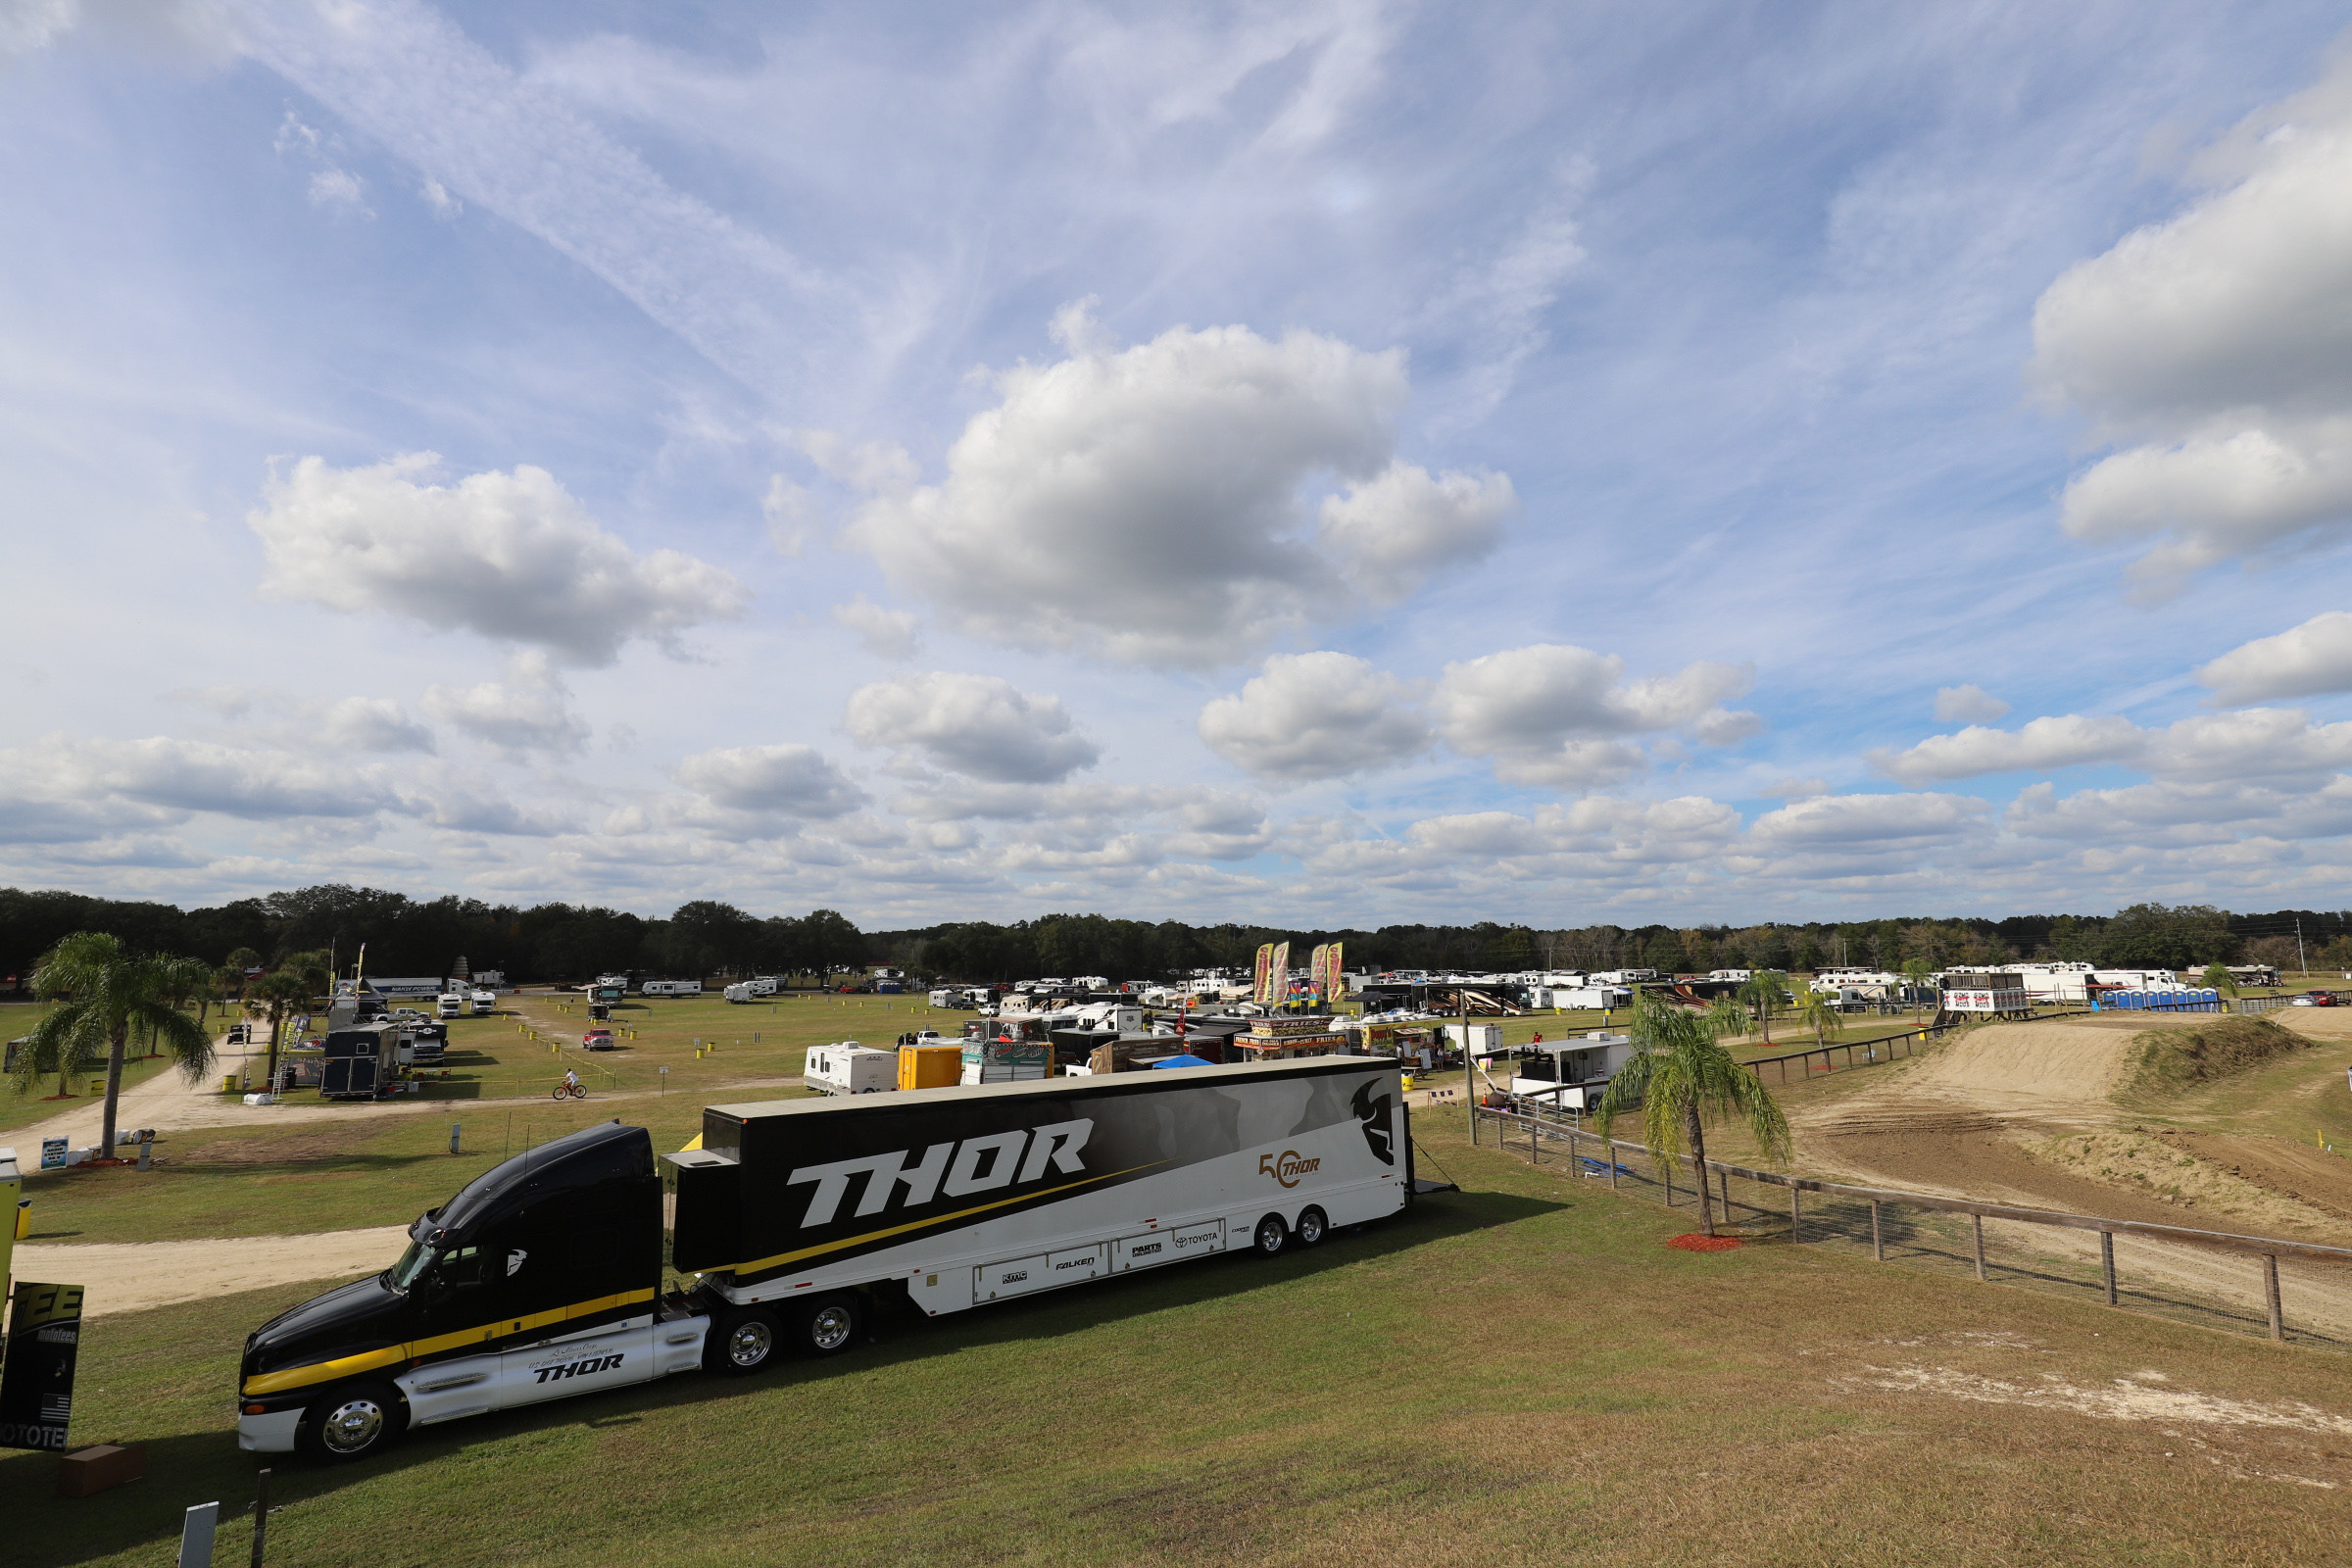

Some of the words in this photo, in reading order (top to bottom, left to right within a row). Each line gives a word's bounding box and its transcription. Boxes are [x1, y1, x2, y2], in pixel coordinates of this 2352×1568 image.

[786, 1117, 1095, 1229] THOR
[1283, 1157, 1321, 1177] THOR
[1188, 1232, 1218, 1246] TOYOTA
[1132, 1243, 1162, 1254] PARTS
[1132, 1249, 1162, 1258] UNLIMITED
[1055, 1256, 1096, 1271] FALKEN
[533, 1353, 625, 1384] THOR
